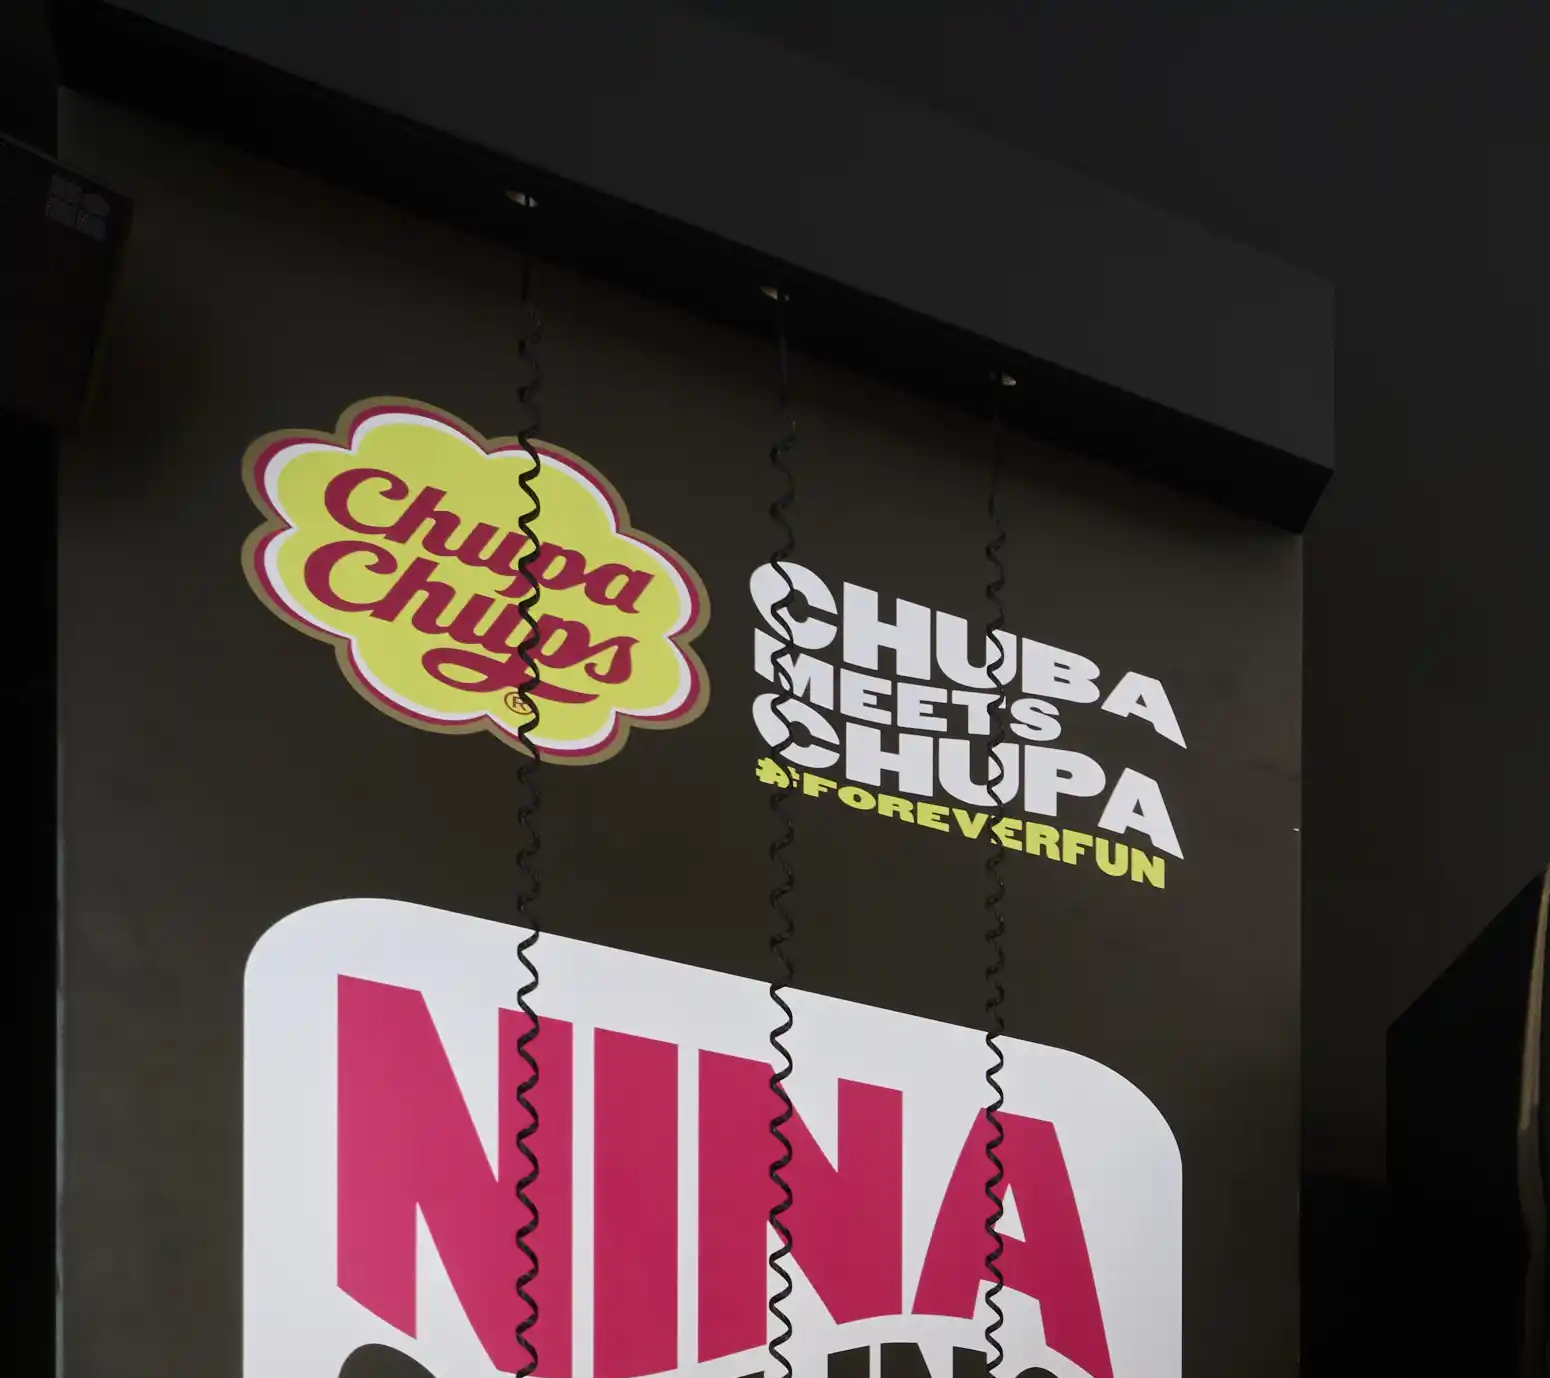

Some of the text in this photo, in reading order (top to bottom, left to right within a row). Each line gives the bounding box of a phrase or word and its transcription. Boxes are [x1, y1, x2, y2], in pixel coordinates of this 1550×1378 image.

[304, 539, 634, 704] Chups
[324, 469, 654, 612] Chupa
[750, 561, 1186, 749] CHUBA
[754, 627, 1062, 741] MEETS
[752, 694, 1184, 859] CHUPA
